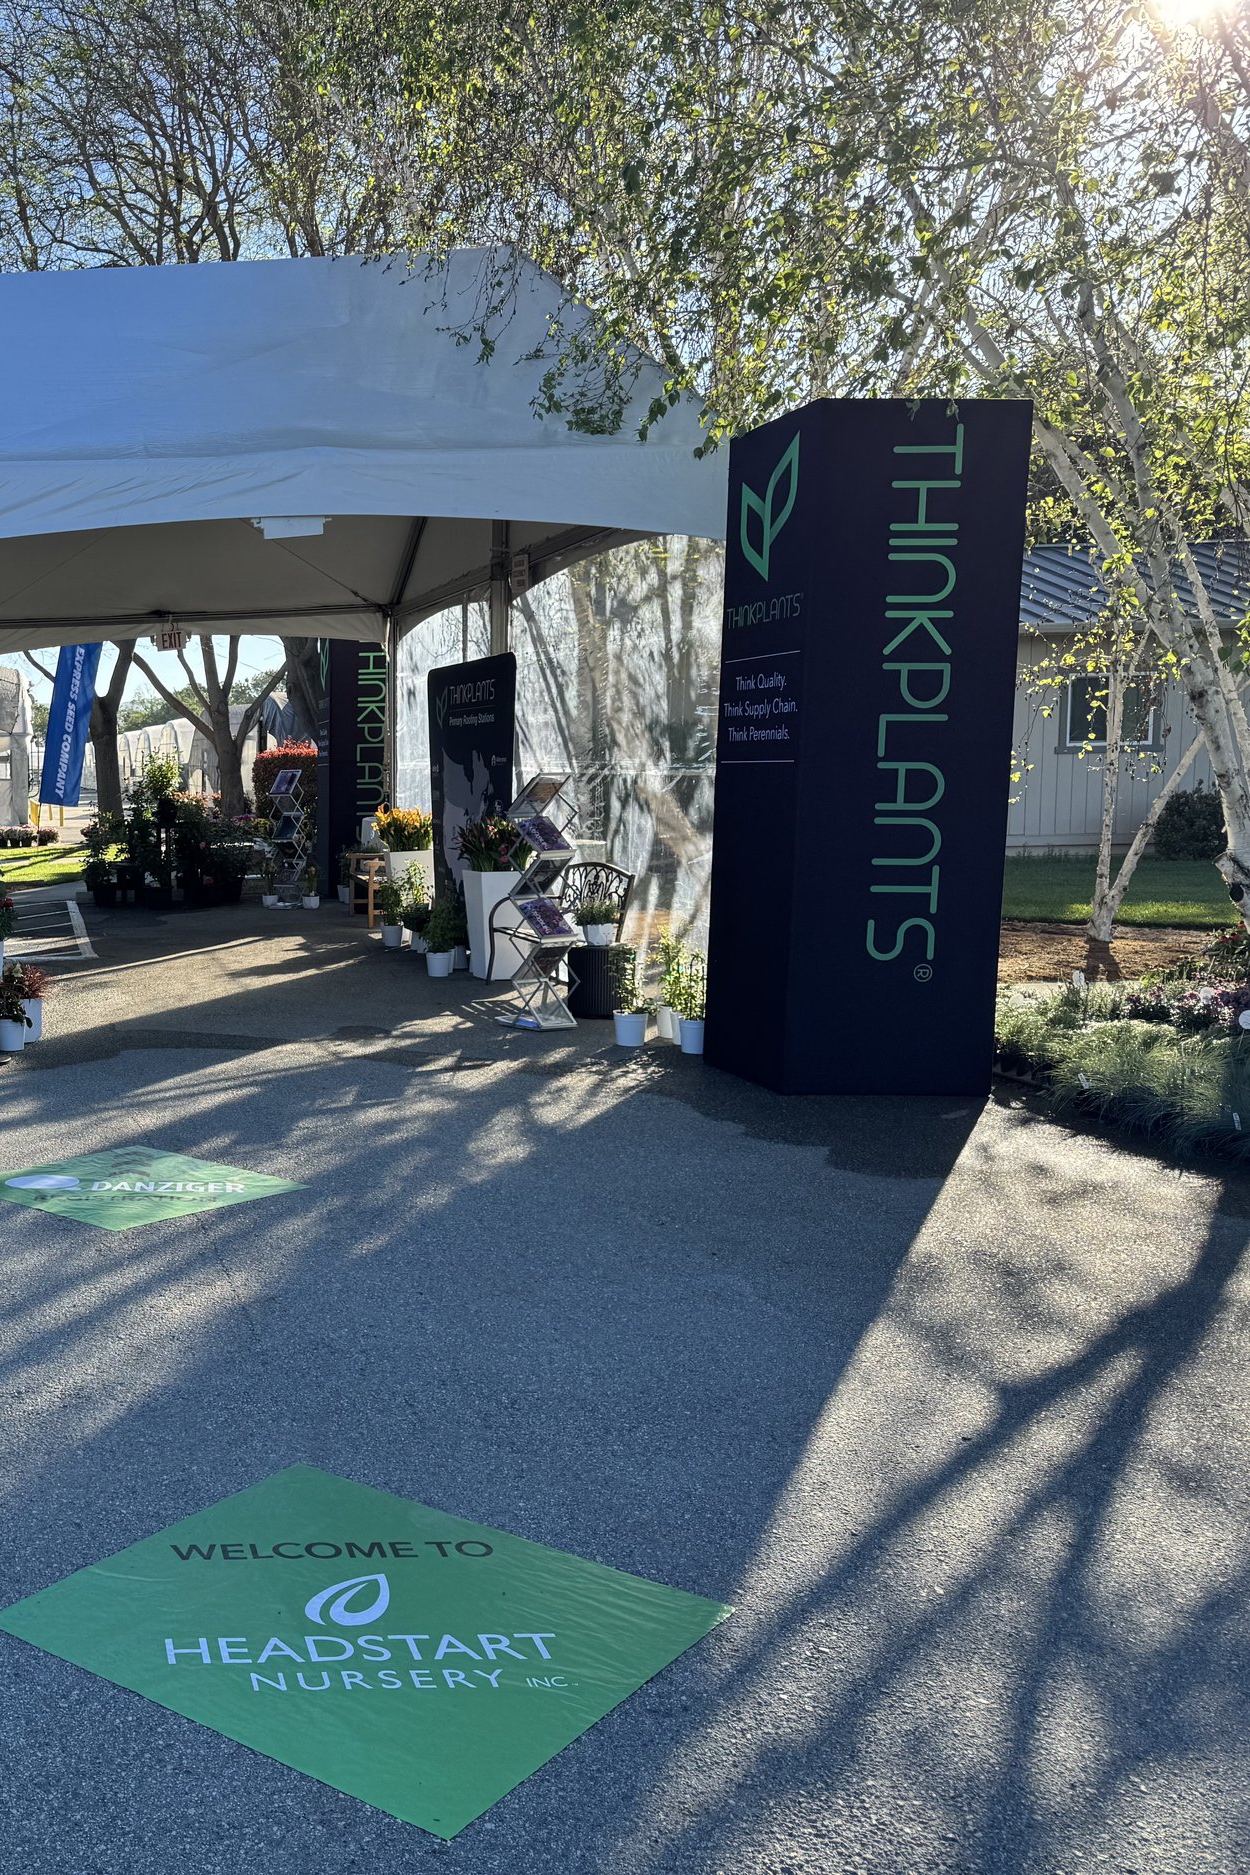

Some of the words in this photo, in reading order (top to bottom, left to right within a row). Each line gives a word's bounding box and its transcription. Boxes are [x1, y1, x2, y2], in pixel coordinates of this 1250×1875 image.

[161, 632, 182, 649] EXIT
[70, 645, 86, 701] EXPRESS
[736, 674, 755, 691] Think
[757, 672, 787, 691] Quality.
[449, 679, 495, 705] THINKPLANTS
[64, 701, 76, 733] SEED
[724, 701, 743, 717] Think
[744, 698, 771, 719] Supply
[772, 698, 798, 714] Chain.
[728, 726, 748, 741] Think
[749, 724, 790, 741] Perennials.
[55, 733, 72, 799] COMPANY
[91, 1181, 246, 1193] DANZIGER
[169, 1541, 419, 1561] WELCOME
[423, 1540, 494, 1558] TO
[164, 1633, 557, 1665] HEADSTART
[250, 1668, 503, 1692] NURSERY
